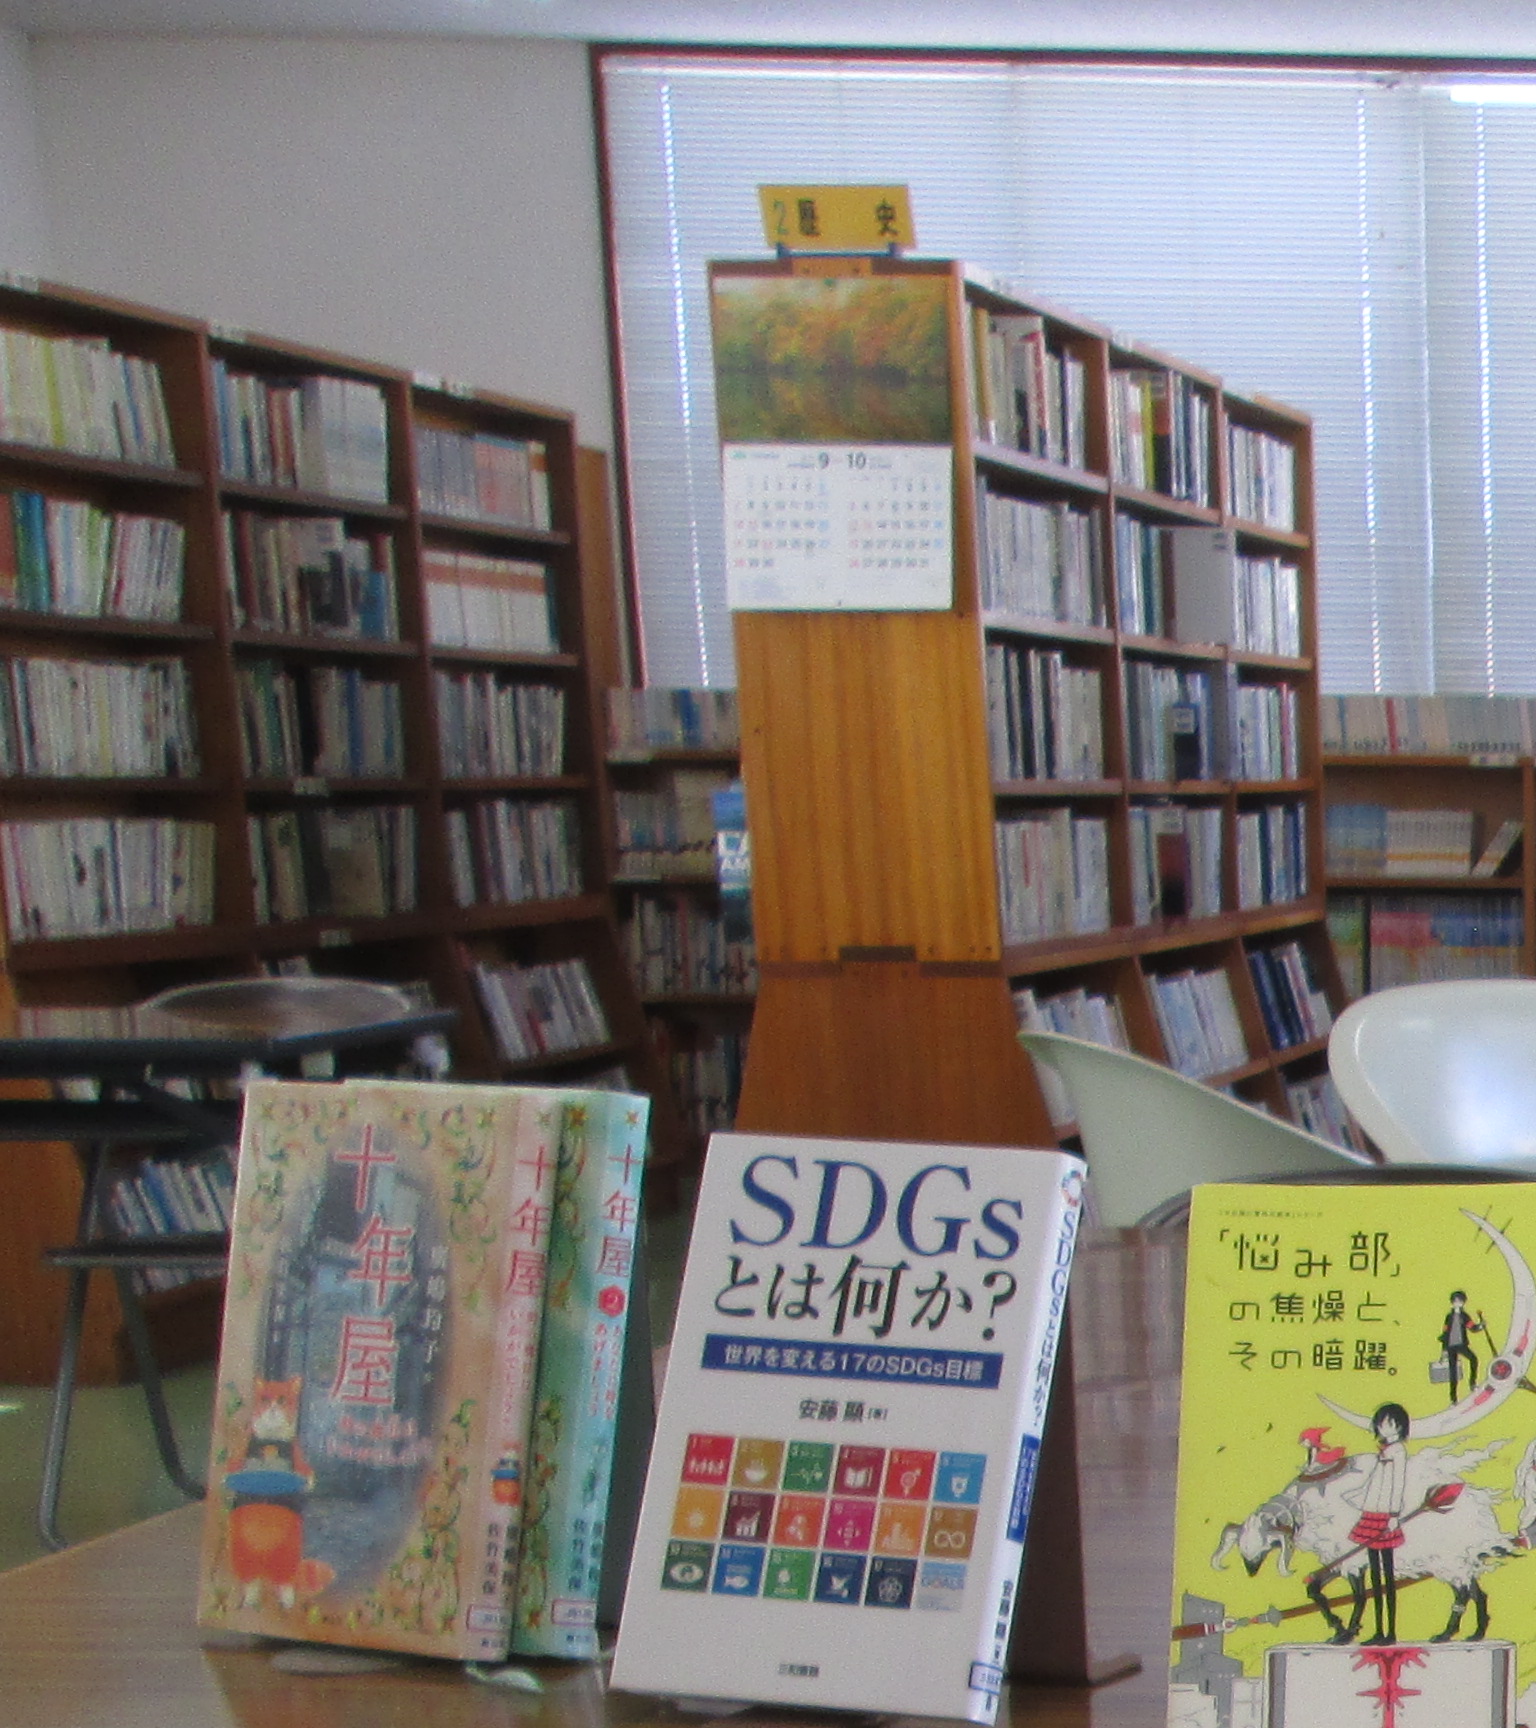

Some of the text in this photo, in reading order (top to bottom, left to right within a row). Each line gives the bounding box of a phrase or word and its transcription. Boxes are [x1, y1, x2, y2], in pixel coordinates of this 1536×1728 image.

[505, 1144, 554, 1299] 十年屋
[596, 1143, 642, 1279] 十年屋
[729, 1154, 1024, 1262] SDGs
[331, 1124, 416, 1406] 十年屋
[715, 1254, 1017, 1341] とは何か?
[1219, 1230, 1401, 1279] 「悩み部」
[1229, 1291, 1399, 1327] の焦燥と、
[724, 1344, 984, 1382] 世界を変える17のSDGs目標
[1229, 1340, 1398, 1377] その暗躍。
